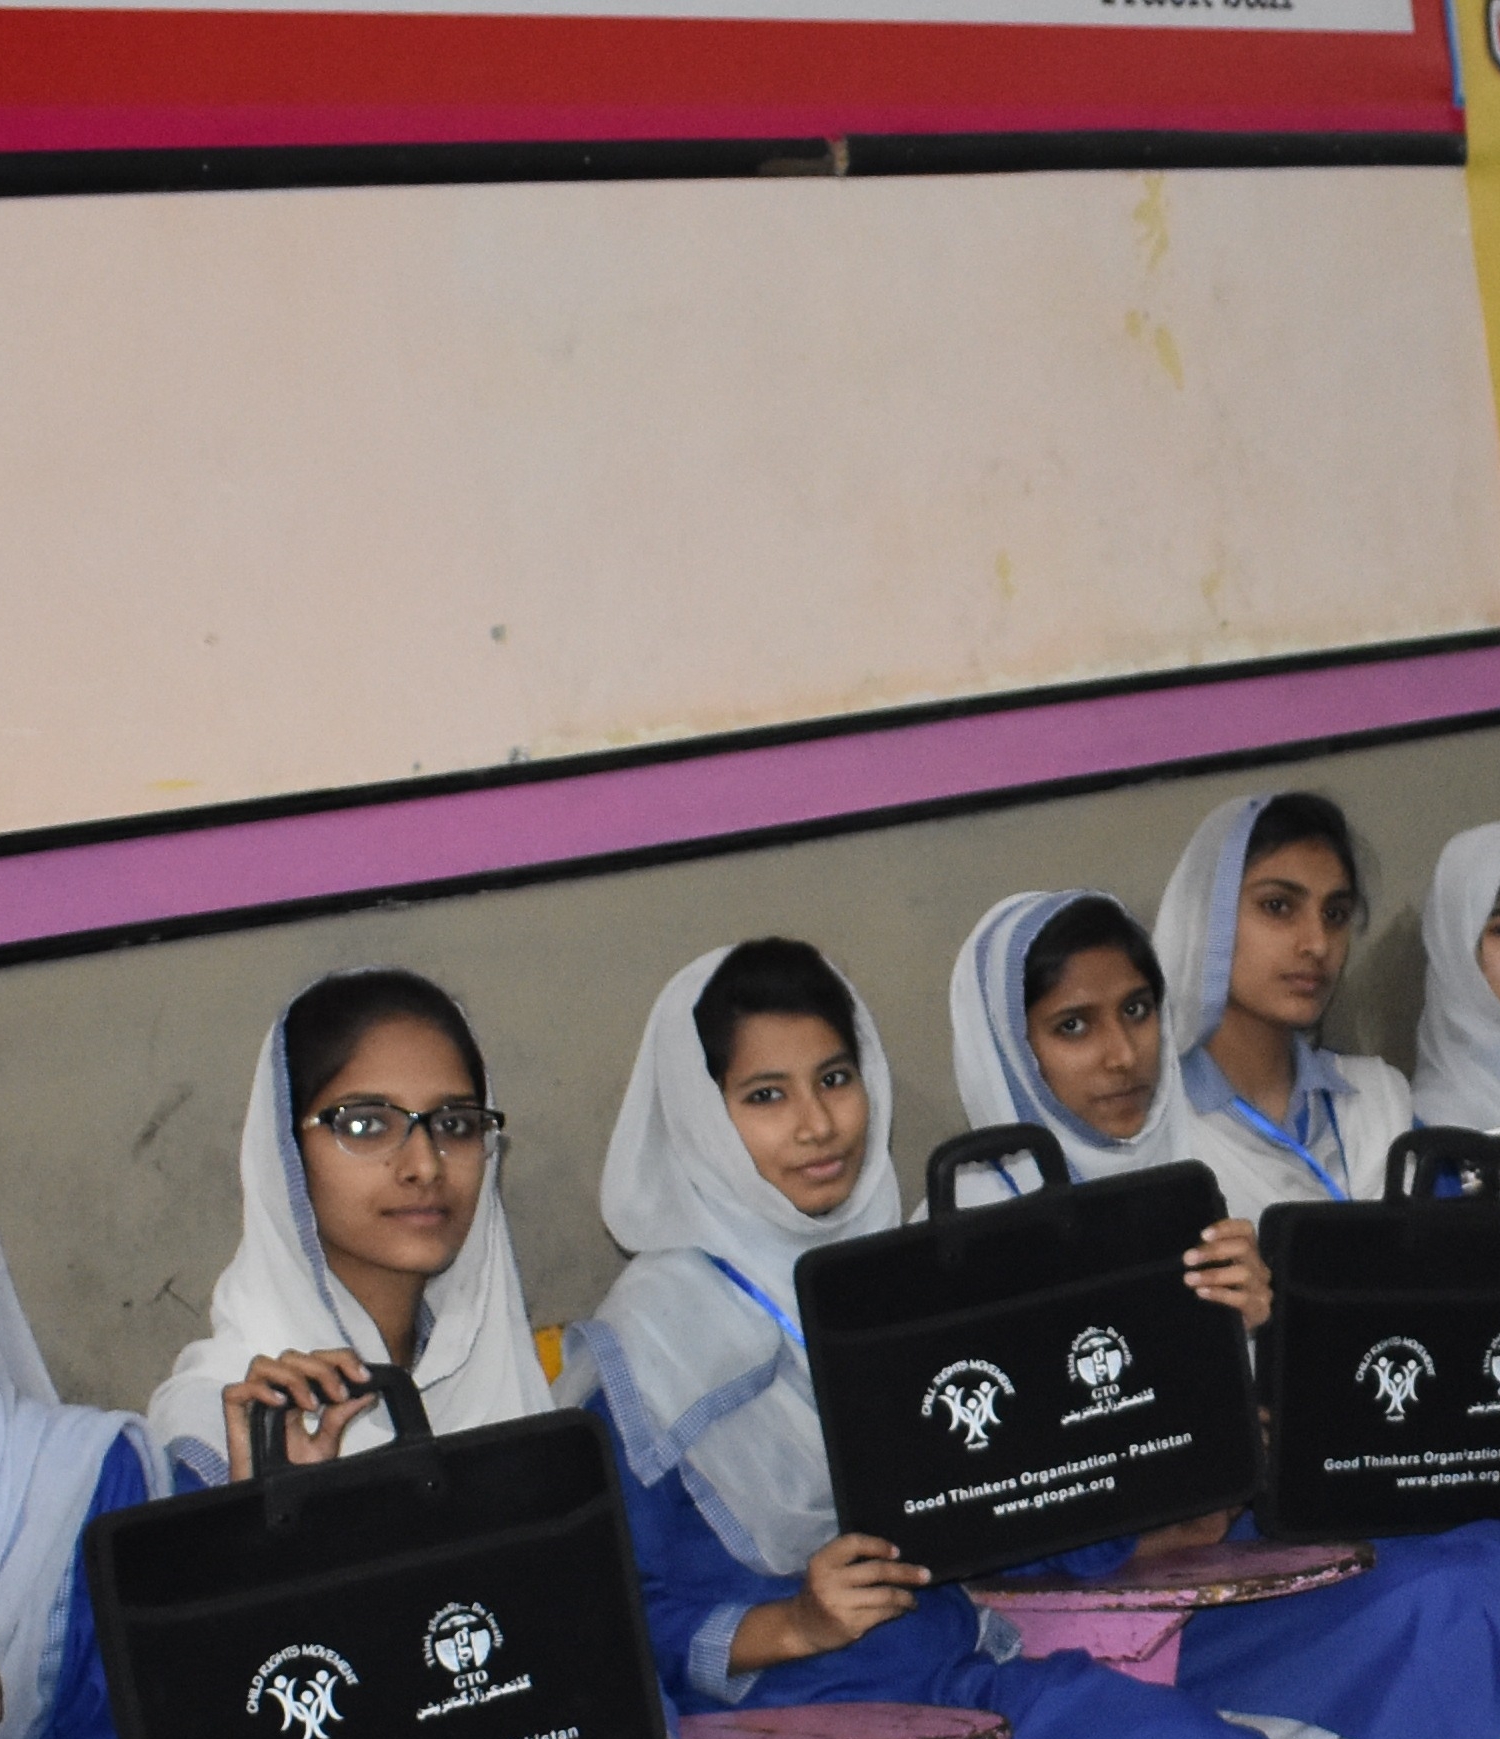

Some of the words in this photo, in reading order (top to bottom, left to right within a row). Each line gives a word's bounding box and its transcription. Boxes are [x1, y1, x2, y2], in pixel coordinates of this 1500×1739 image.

[1091, 1383, 1121, 1401] GTO
[904, 1491, 947, 1515] Good
[948, 1477, 1018, 1504] Thinkers
[1020, 1451, 1118, 1487] Organization
[1128, 1430, 1194, 1459] Pakistan
[1323, 1456, 1360, 1473] Good
[1363, 1448, 1421, 1469] Thinkers
[993, 1473, 1117, 1517] www.gtopak.org
[245, 1673, 266, 1715] CHILD
[257, 1643, 301, 1679] RIGHTS
[301, 1643, 361, 1686] MOVEMENT
[453, 1669, 489, 1691] GTO
